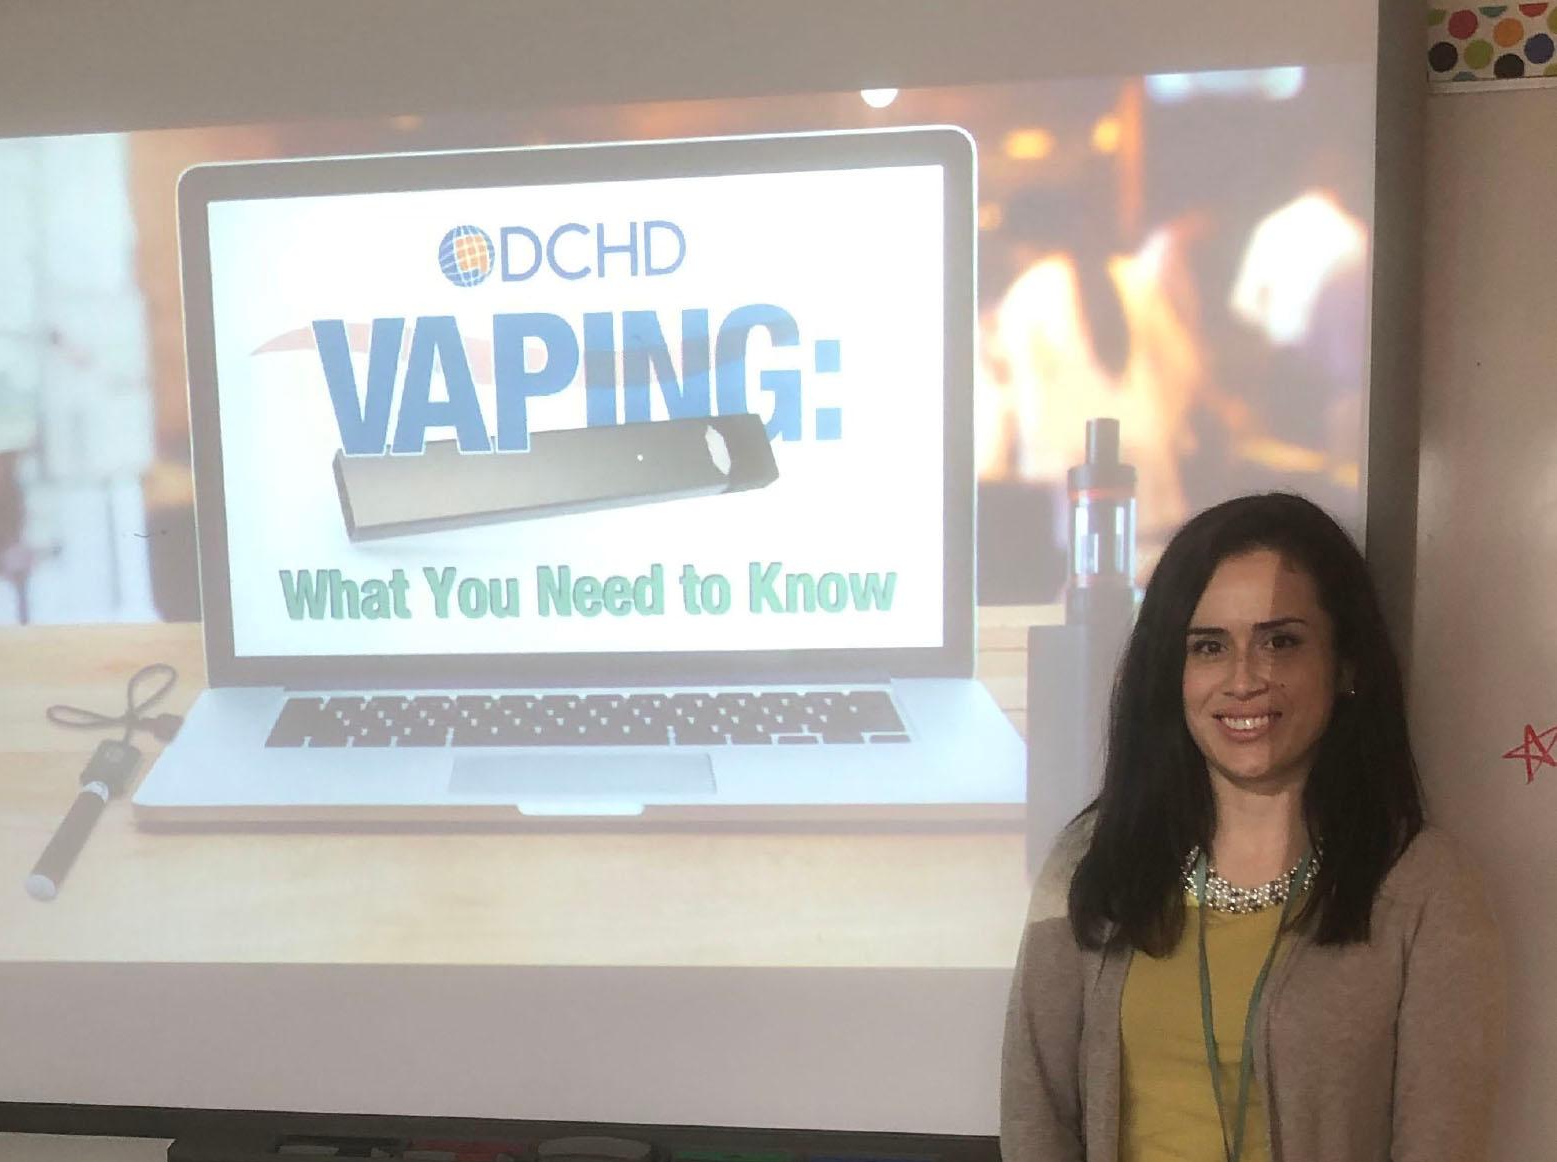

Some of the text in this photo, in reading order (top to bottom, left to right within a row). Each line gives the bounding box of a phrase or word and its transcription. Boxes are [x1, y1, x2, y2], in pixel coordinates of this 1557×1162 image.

[499, 220, 687, 282] DCHD
[312, 303, 843, 456] VAPING:
[279, 561, 898, 619] What You Need to Know
